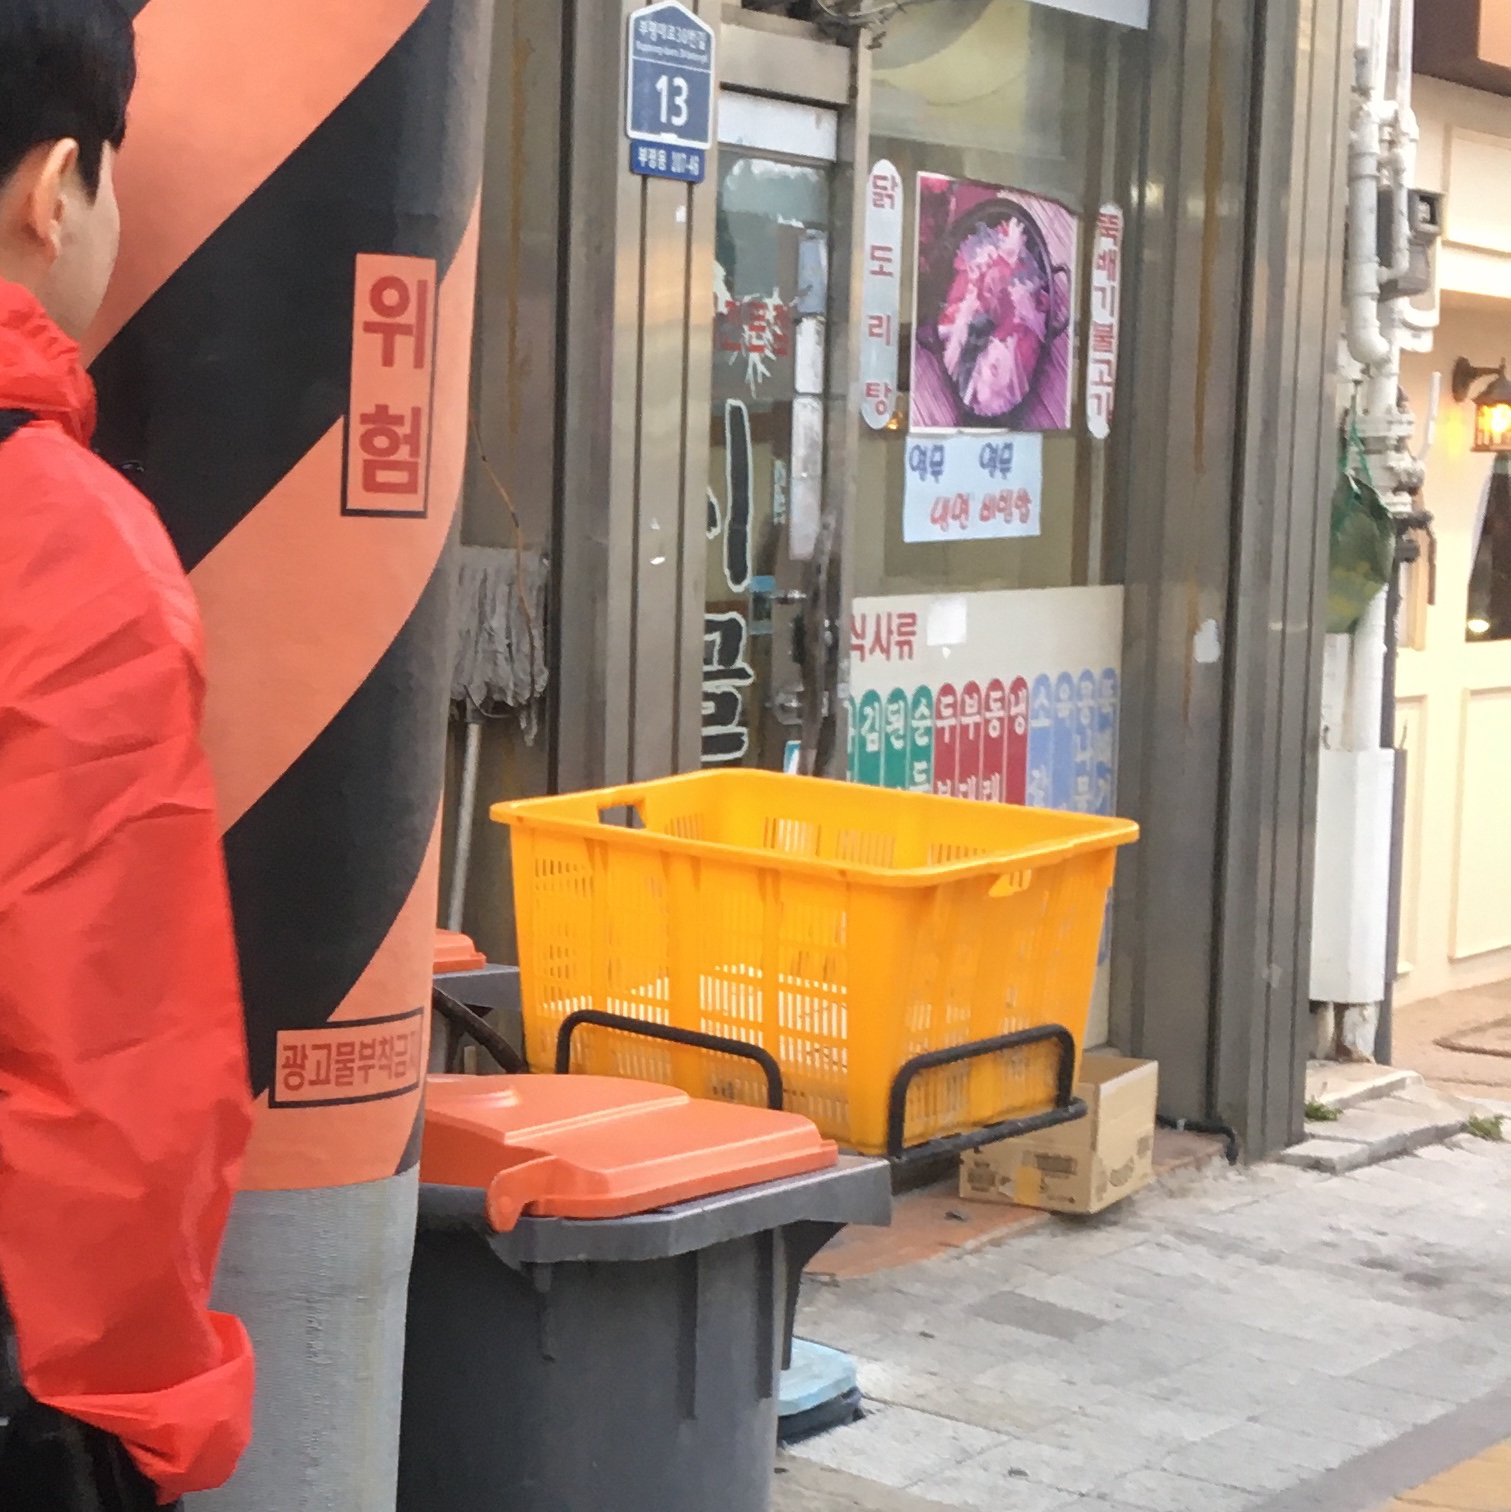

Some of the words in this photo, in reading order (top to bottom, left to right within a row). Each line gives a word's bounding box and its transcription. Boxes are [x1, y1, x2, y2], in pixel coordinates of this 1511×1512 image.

[655, 74, 689, 127] 13
[865, 174, 900, 416] 닭도리탕
[359, 275, 429, 494] 위험
[850, 611, 918, 662] 식사류
